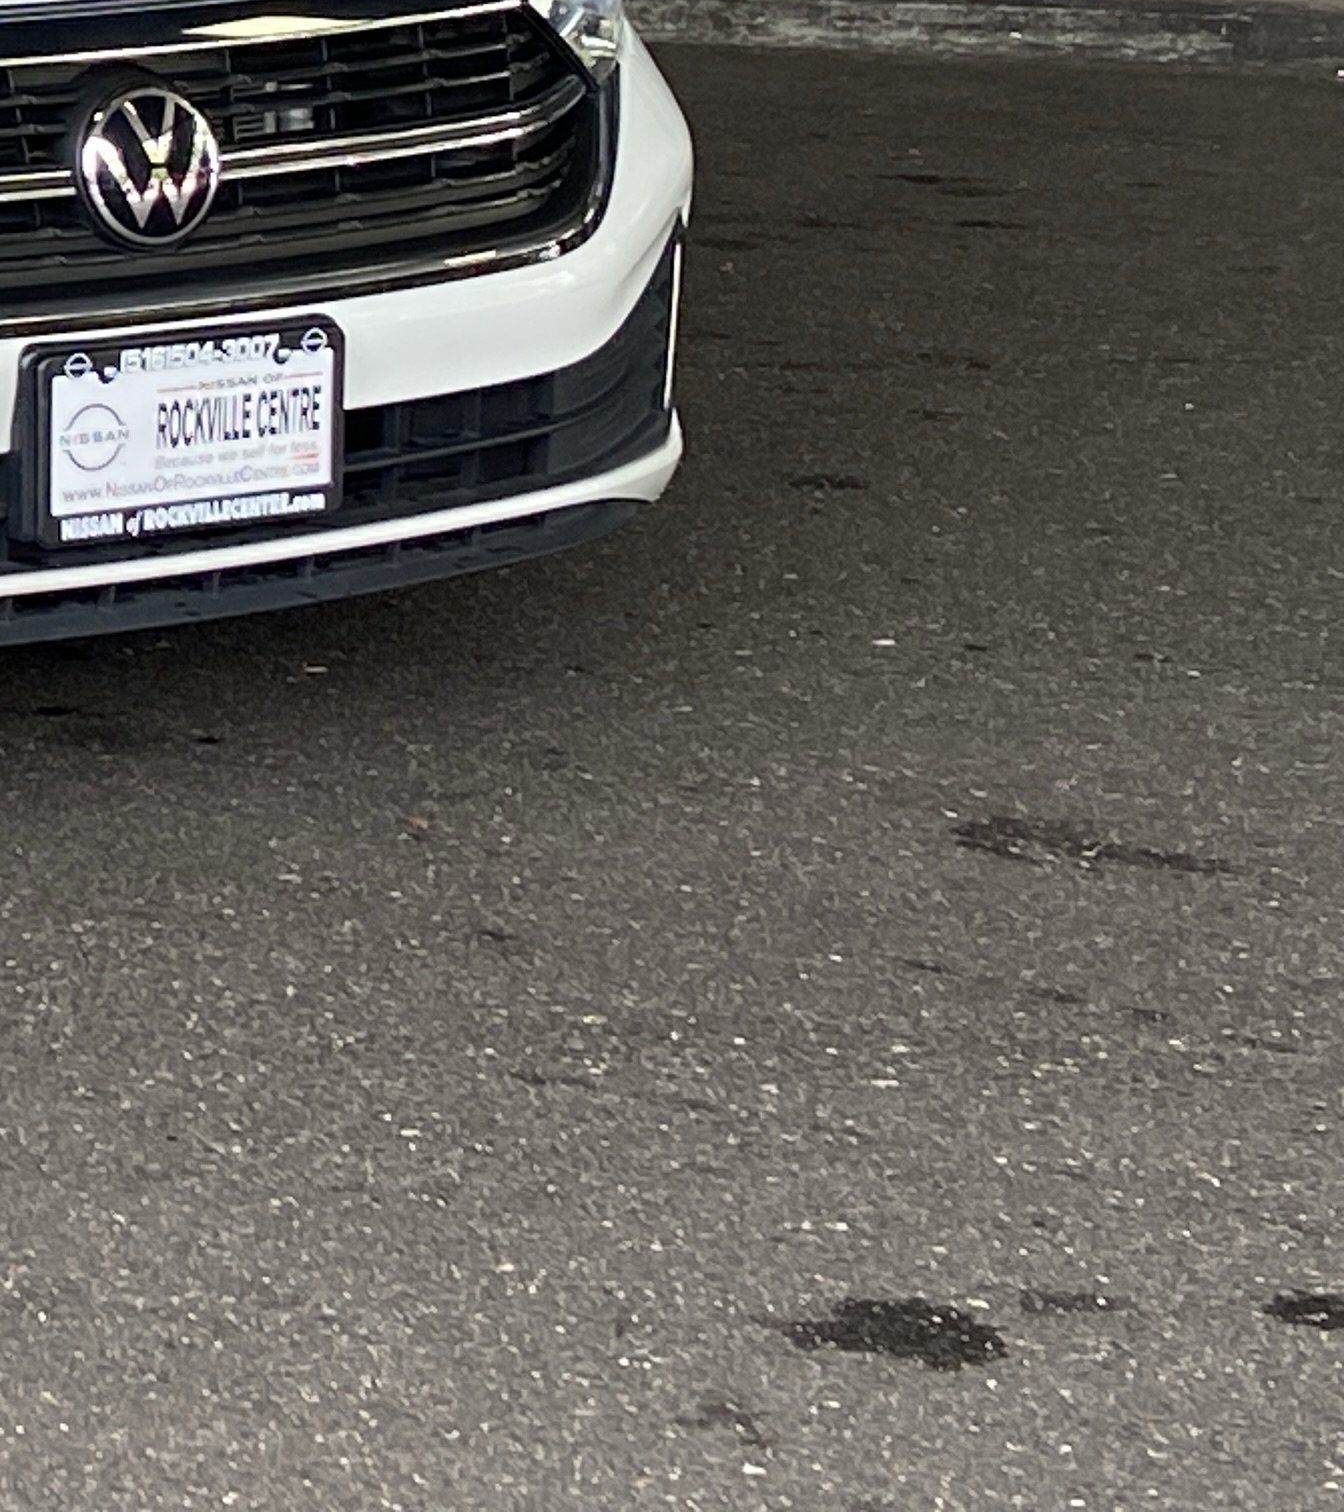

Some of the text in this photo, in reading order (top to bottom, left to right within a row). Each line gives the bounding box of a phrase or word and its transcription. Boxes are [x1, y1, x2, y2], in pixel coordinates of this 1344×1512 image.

[155, 385, 323, 449] ROCKVILLE CENTRE
[59, 429, 130, 447] NISSAN
[60, 512, 124, 541] NISSAN
[125, 509, 144, 537] of
